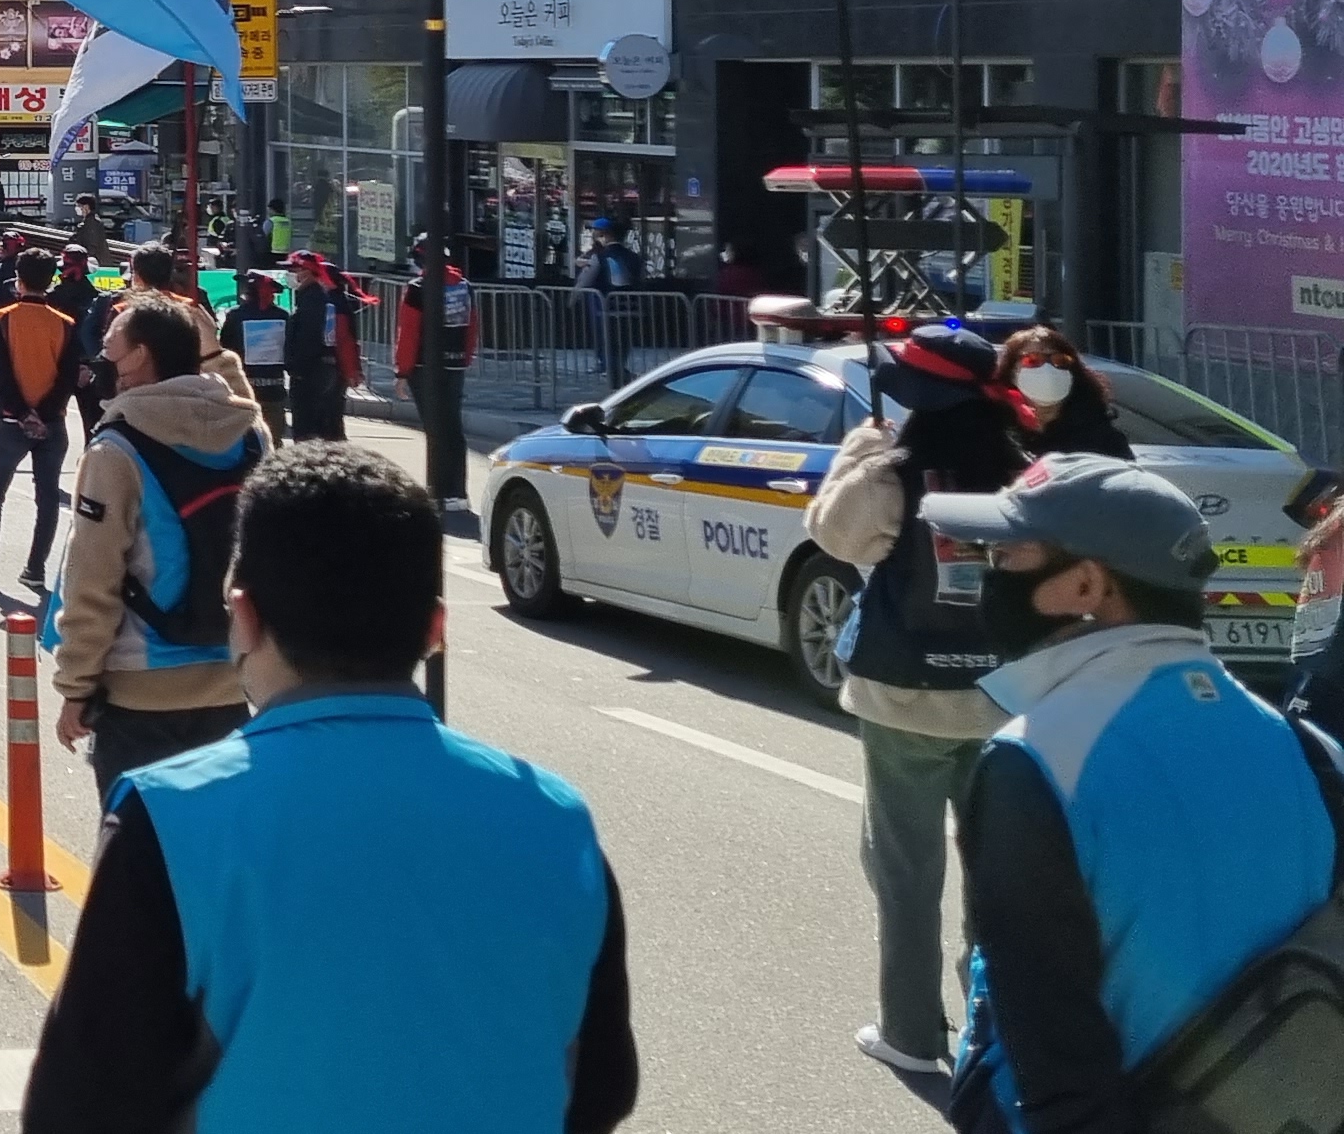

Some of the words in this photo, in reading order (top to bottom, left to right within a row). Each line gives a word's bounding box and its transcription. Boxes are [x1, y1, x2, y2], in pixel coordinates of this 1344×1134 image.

[498, 0, 538, 29] 오늘은
[1247, 149, 1331, 182] 2020년도
[1226, 191, 1269, 219] 당신을
[1213, 224, 1252, 247] Merry
[1257, 228, 1320, 250] Christmas
[631, 506, 661, 541] 경찰
[702, 519, 769, 560] POLICE
[1227, 621, 1285, 645] 6191
